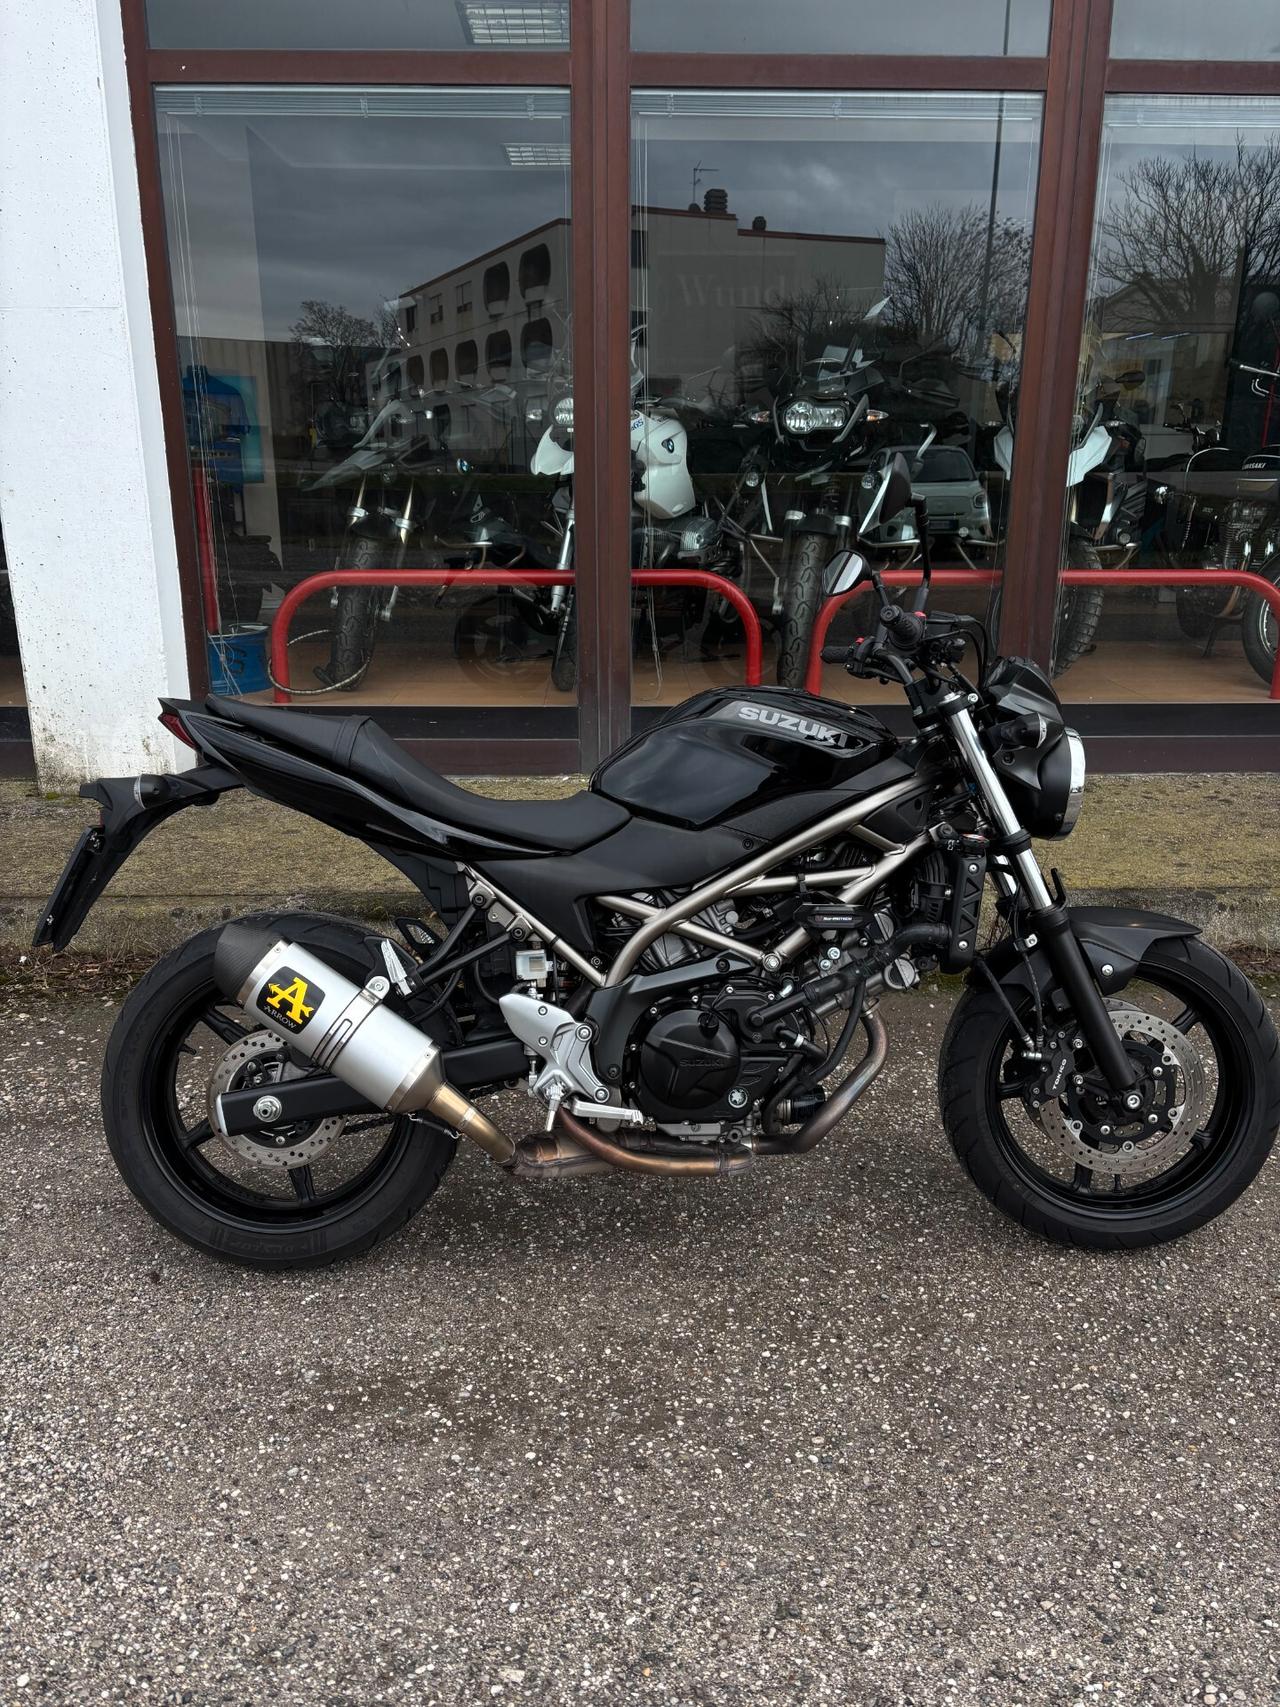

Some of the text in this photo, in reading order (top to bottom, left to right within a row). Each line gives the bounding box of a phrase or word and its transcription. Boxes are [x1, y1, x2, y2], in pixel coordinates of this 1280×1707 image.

[738, 705, 848, 748] SUZUKI
[263, 1005, 298, 1029] ARROW
[679, 1058, 724, 1068] SUZUKI
[1052, 1058, 1068, 1090] TOKICO
